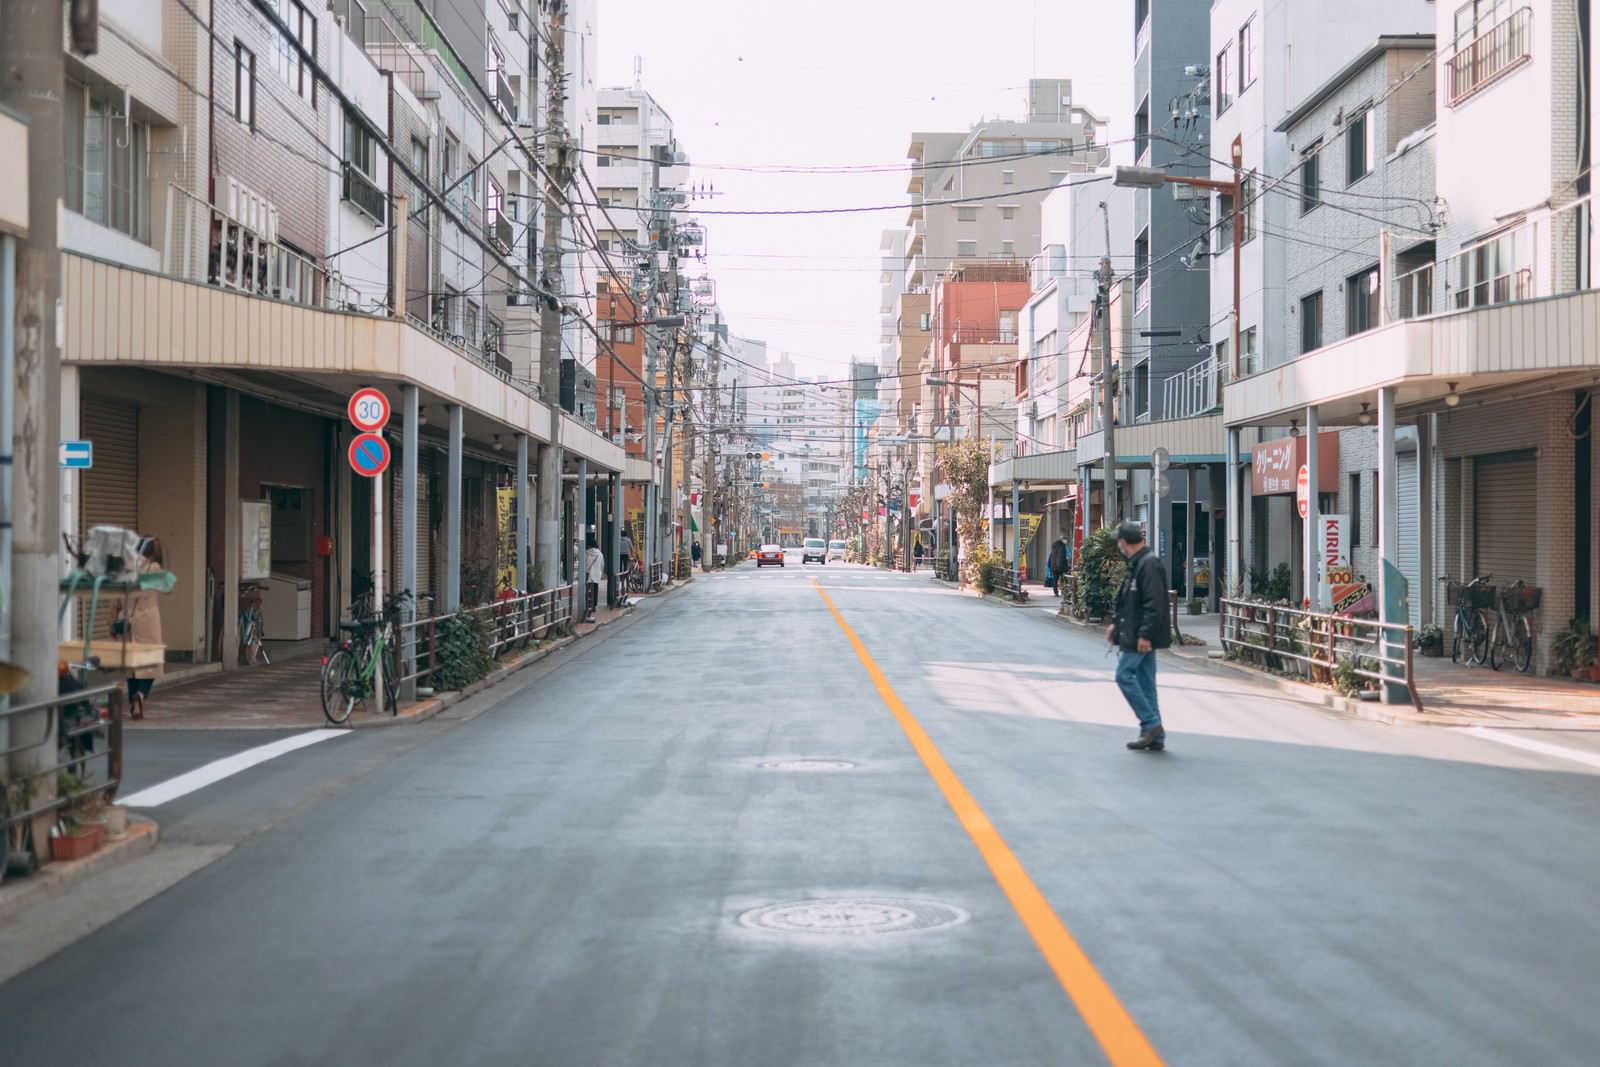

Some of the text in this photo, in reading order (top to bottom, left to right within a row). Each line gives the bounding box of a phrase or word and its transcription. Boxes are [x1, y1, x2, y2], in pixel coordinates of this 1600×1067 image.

[360, 401, 380, 419] 30
[1257, 444, 1291, 474] クリーニング
[1326, 520, 1339, 566] KIRIN
[1327, 572, 1350, 584] 100
